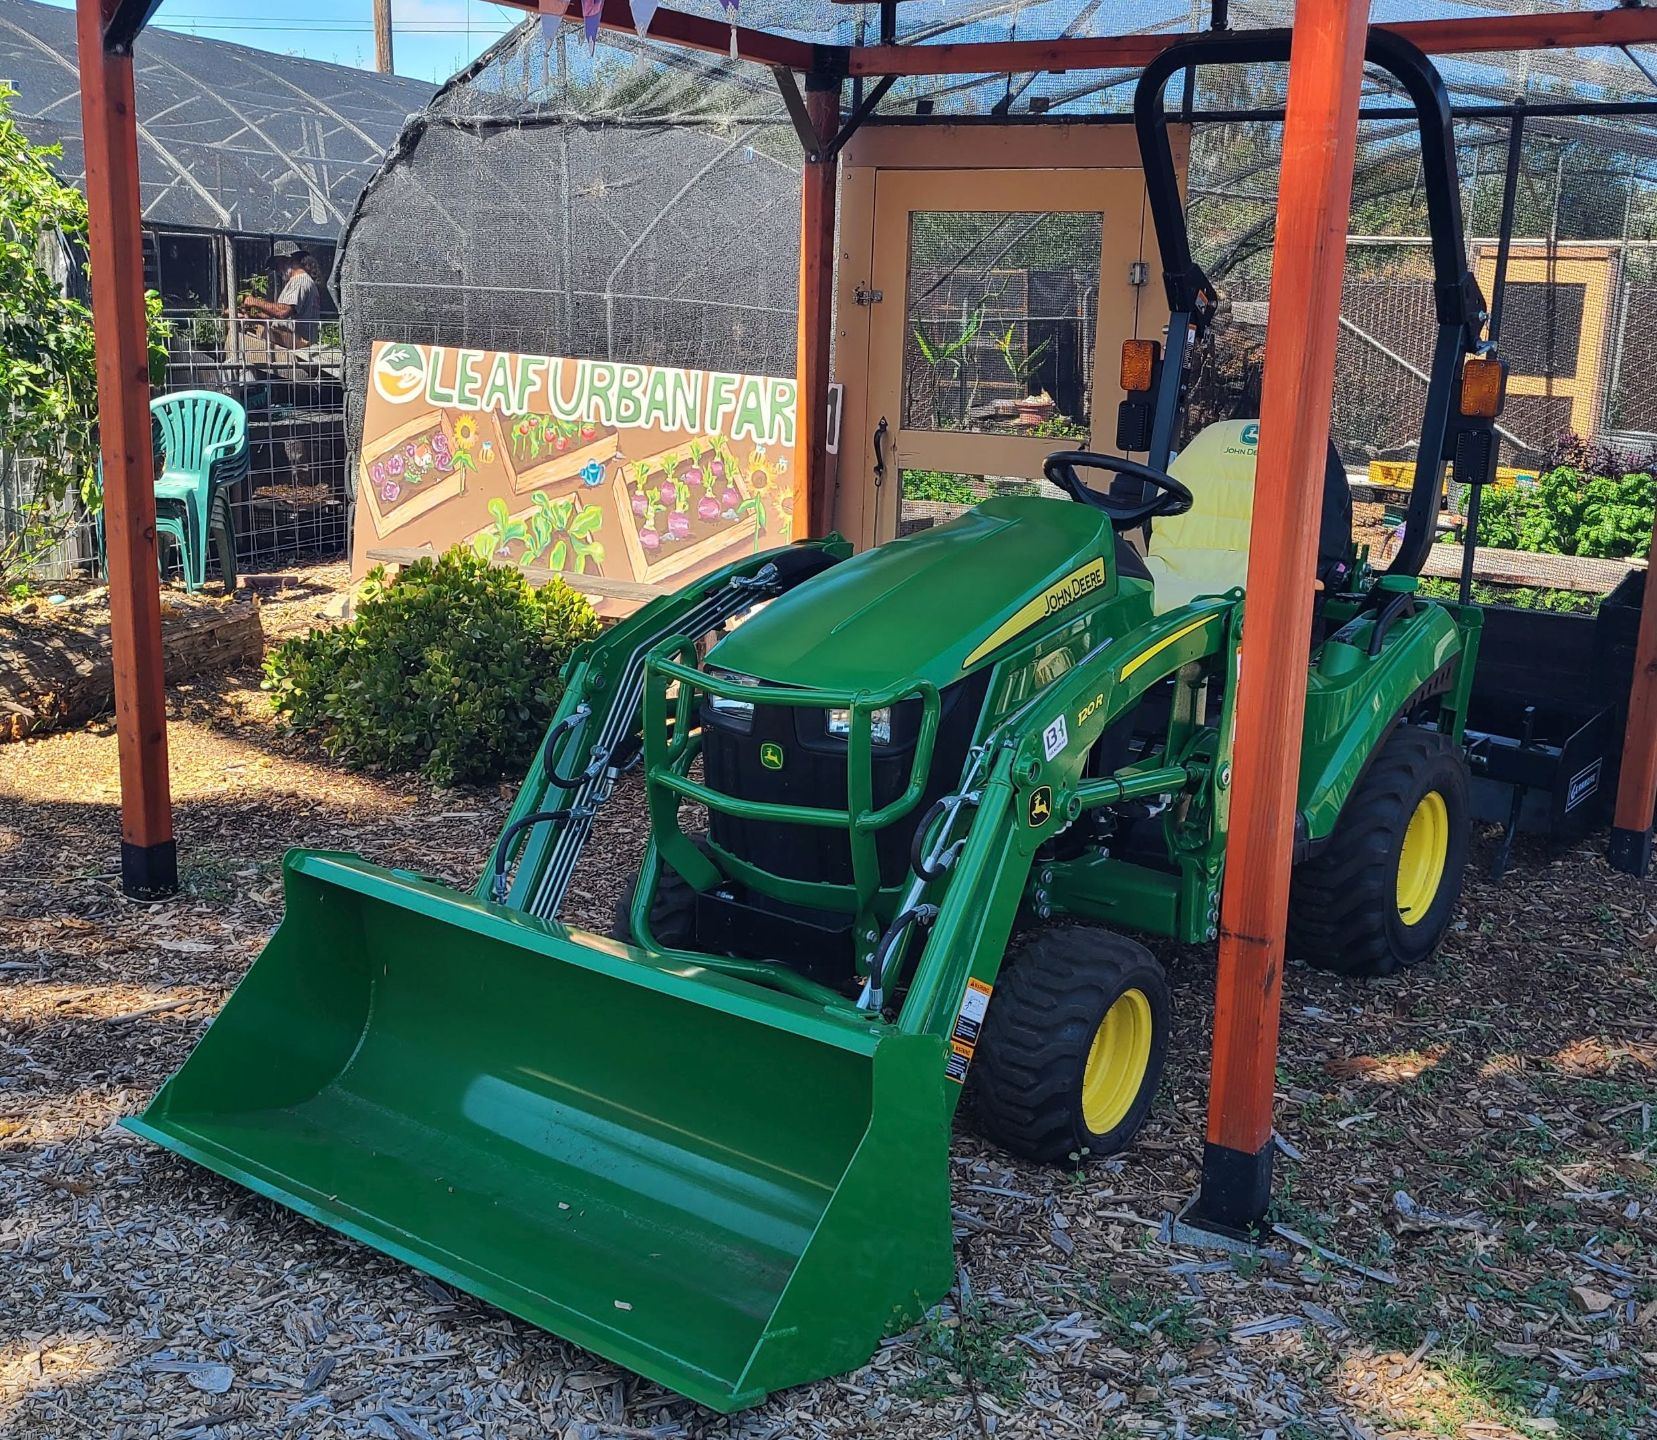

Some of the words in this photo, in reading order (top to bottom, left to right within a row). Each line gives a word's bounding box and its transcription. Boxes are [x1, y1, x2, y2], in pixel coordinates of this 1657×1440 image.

[428, 348, 548, 413] LEAF
[551, 359, 701, 431] URBAN
[707, 374, 797, 445] FAR
[1224, 446, 1246, 455] JOHN
[1044, 585, 1073, 615] JOHN
[1072, 569, 1103, 597] DEERE
